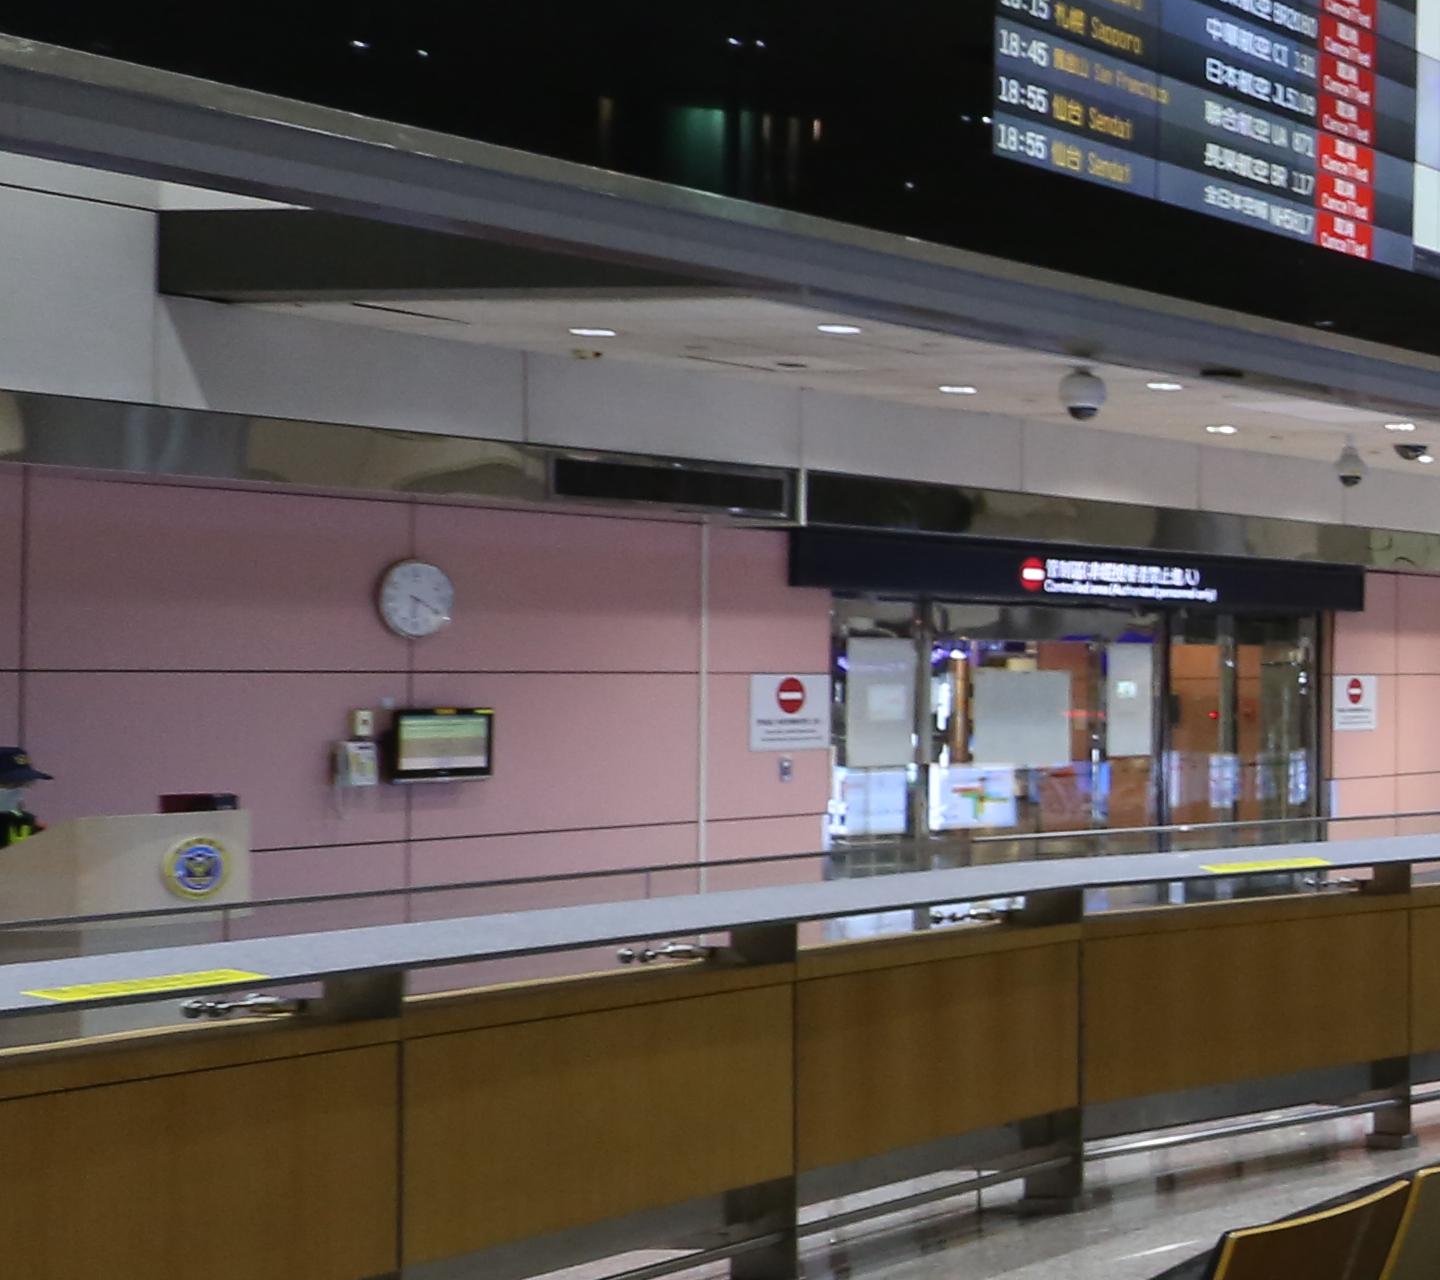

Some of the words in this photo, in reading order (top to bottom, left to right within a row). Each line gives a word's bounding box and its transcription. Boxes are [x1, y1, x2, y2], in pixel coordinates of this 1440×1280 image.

[1000, 29, 1047, 67] 18:45
[999, 76, 1047, 113] 18:55
[1206, 57, 1269, 101] 日本航空
[997, 124, 1045, 159] 18:55
[1044, 579, 1090, 595] Controlled
